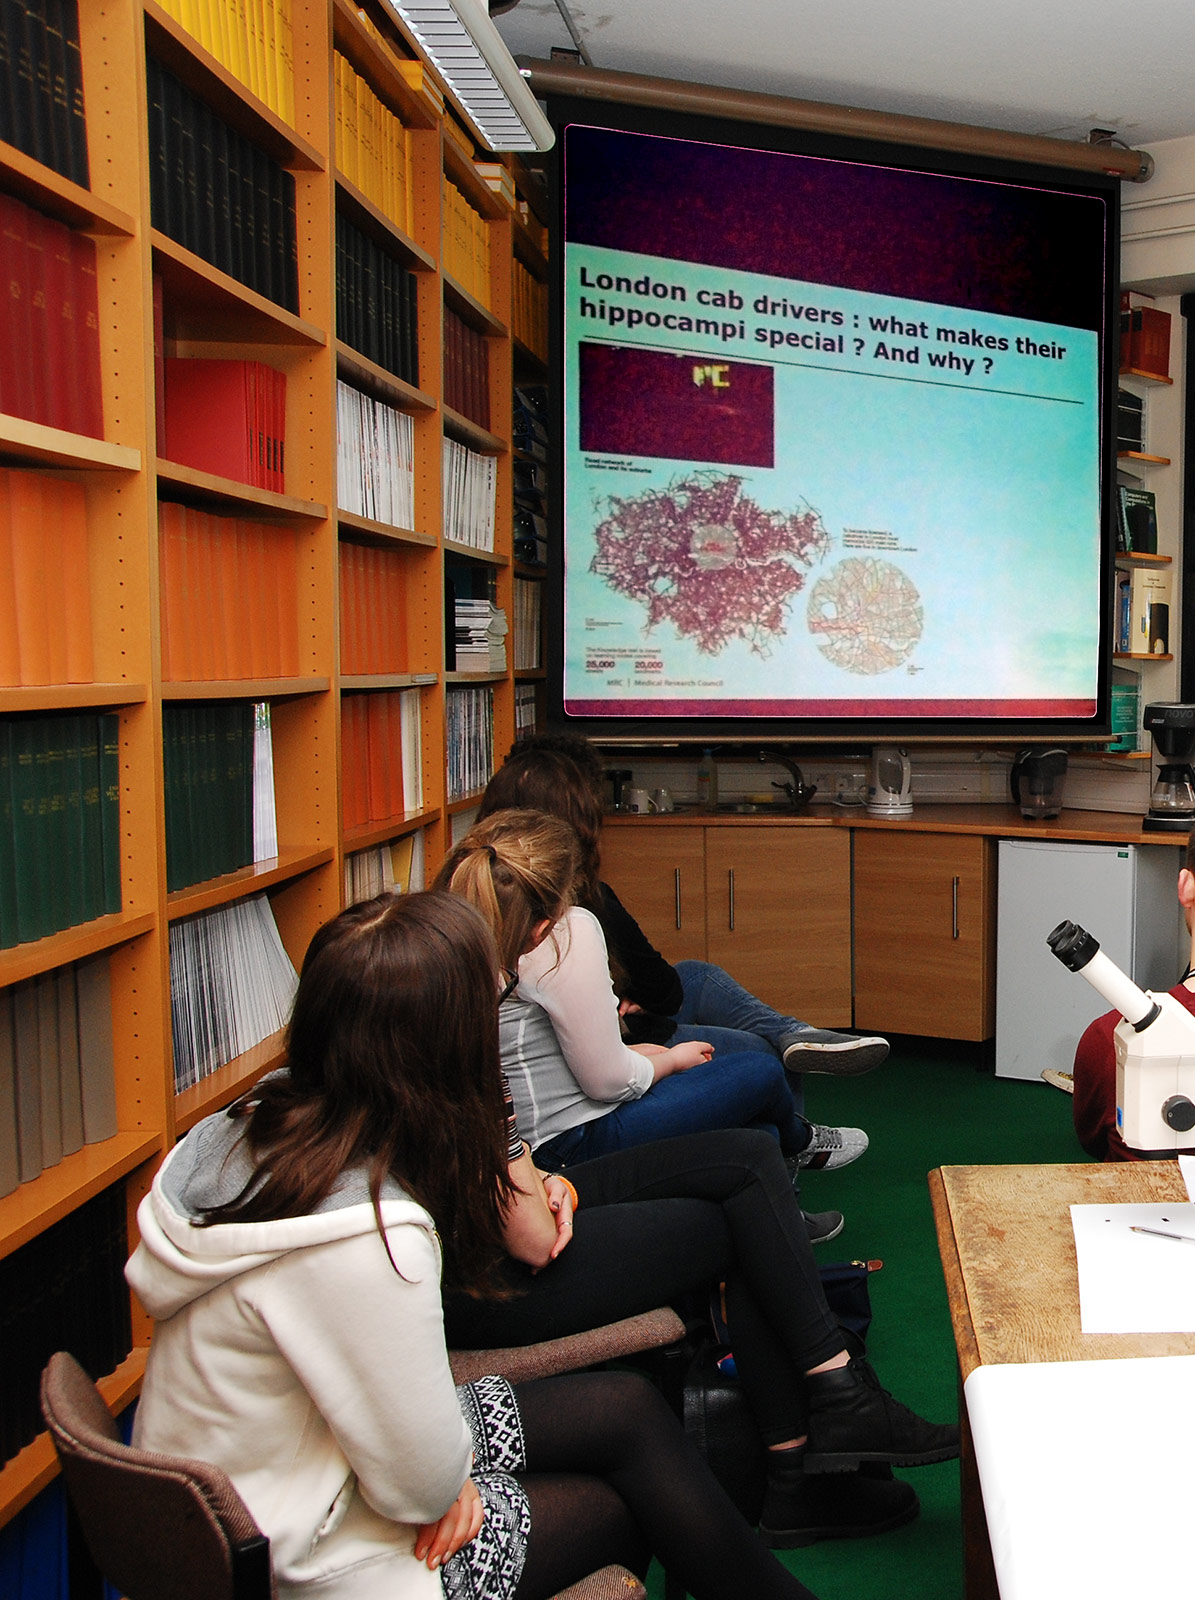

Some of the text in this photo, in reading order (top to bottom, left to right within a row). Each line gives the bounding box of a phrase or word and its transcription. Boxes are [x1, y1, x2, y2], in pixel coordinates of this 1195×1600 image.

[579, 267, 686, 301] London
[697, 287, 743, 311] cab
[754, 295, 843, 326] drivers
[869, 314, 929, 340] what
[936, 325, 1009, 352] makes
[1015, 335, 1066, 360] their
[579, 297, 746, 341] hippocampi
[755, 325, 844, 353] special
[873, 342, 920, 365] And
[927, 349, 975, 375] why
[635, 661, 664, 670] 20,000
